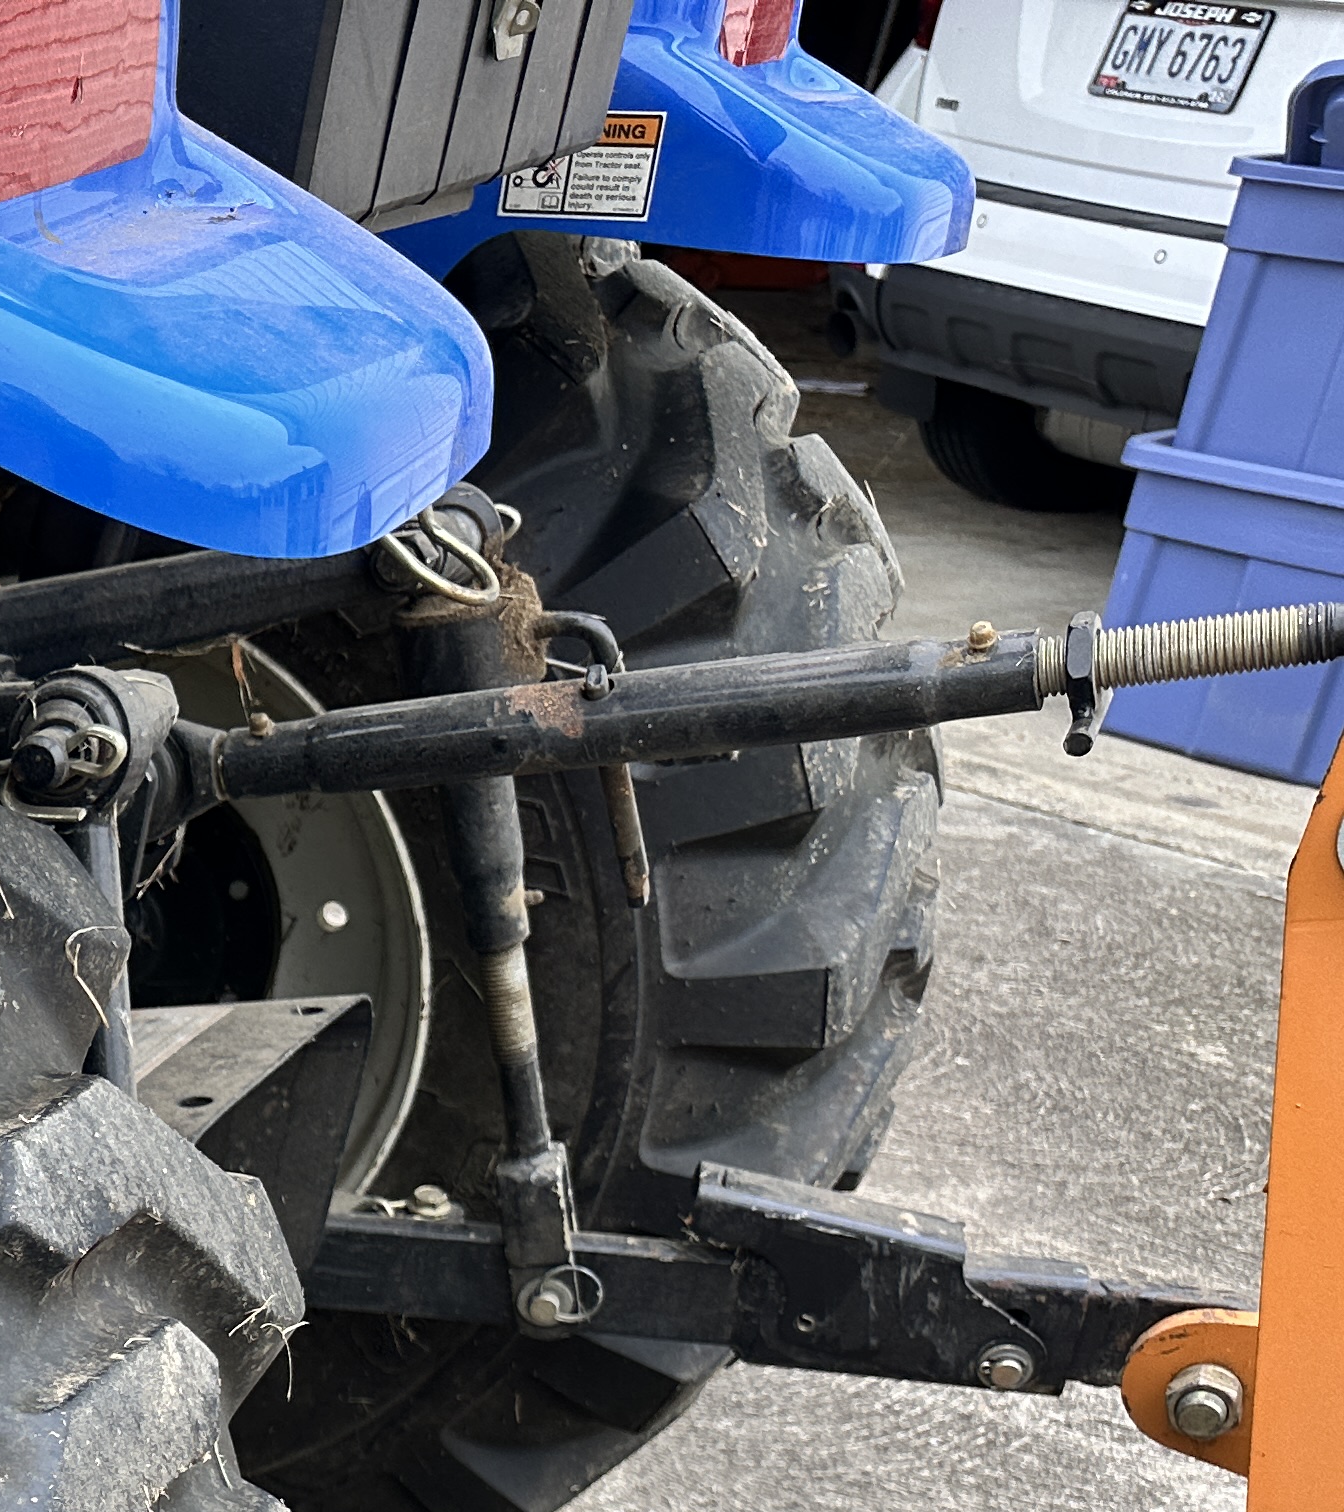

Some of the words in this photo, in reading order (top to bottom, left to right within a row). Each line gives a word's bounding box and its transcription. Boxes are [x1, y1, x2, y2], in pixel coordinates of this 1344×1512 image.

[1154, 1, 1237, 24] JOSEPH
[1111, 24, 1175, 75] GMY
[1167, 31, 1247, 84] 6763
[603, 124, 647, 139] NING
[635, 152, 651, 162] only
[595, 161, 623, 169] Tractor
[573, 173, 601, 181] Failure
[601, 174, 611, 182] to
[611, 175, 642, 184] comply
[596, 183, 621, 191] result
[621, 184, 630, 192] in
[569, 192, 593, 200] death
[594, 193, 604, 201] or
[605, 193, 636, 201] serious
